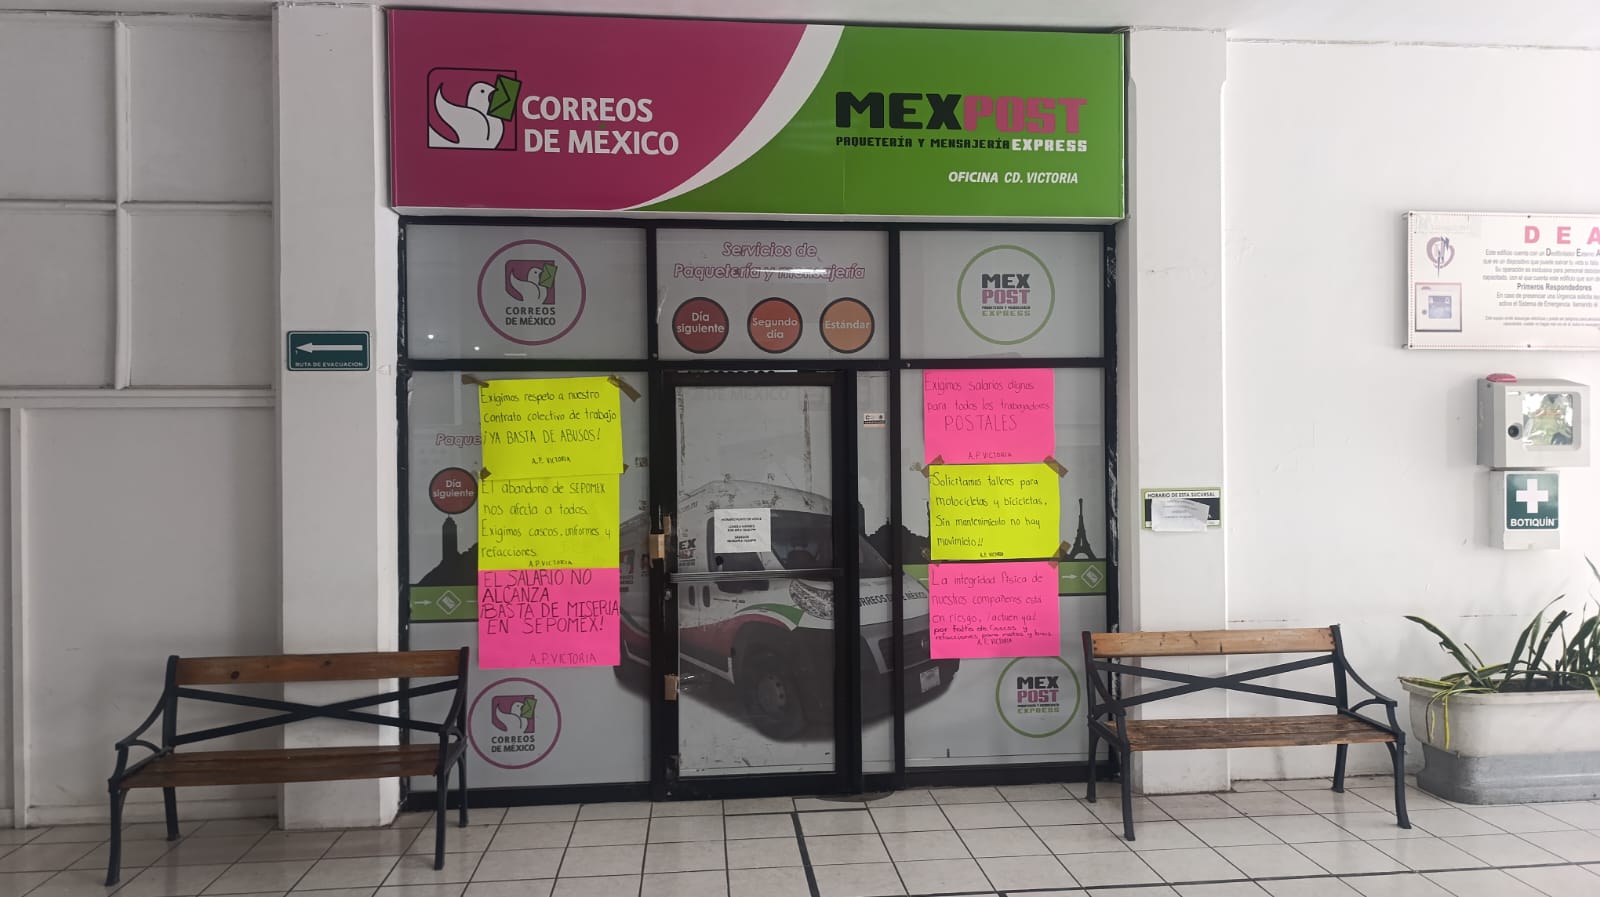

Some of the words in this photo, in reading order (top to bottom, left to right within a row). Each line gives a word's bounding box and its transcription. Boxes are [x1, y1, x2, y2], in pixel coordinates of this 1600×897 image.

[522, 95, 653, 123] CORREOS
[835, 91, 1088, 134] MEXPOST
[524, 128, 561, 153] DE
[568, 129, 679, 156] MEXICO
[918, 137, 925, 148] Y
[1012, 138, 1088, 152] EXPRESS
[948, 171, 999, 183] OFICINA
[1004, 172, 1023, 184] CD.
[1026, 172, 1078, 184] VICTORIA
[721, 241, 791, 258] Servicios
[795, 242, 818, 257] de
[673, 262, 761, 282] Paquetería
[763, 265, 775, 281] y
[777, 262, 866, 283] mensajería
[981, 273, 1030, 289] MEX
[1516, 282, 1544, 291] Primeros
[1546, 282, 1593, 293] Respondedores
[981, 289, 1030, 305] POST
[505, 306, 556, 316] CORREOS
[691, 311, 710, 322] Día
[505, 317, 517, 326] DE
[519, 315, 556, 326] MÉXICO
[752, 317, 798, 329] Segundo
[824, 318, 871, 330] Estándar
[676, 324, 725, 335] siguiente
[766, 330, 785, 340] día
[924, 372, 962, 396] Exigimos
[1007, 378, 1034, 394] dignos
[480, 387, 520, 406] Exigimos
[524, 391, 555, 405] respeto
[558, 392, 564, 401] a
[568, 390, 600, 400] nuestro
[927, 402, 947, 412] para
[955, 400, 978, 411] todos
[981, 397, 994, 411] los
[527, 410, 565, 422] colectivo
[569, 409, 580, 420] de
[585, 407, 617, 423] trabajo
[944, 413, 1018, 432] POSTALES
[435, 433, 480, 448] Paque
[506, 429, 537, 445] BASTA
[542, 429, 556, 444] DE
[560, 427, 601, 443] ABUSOS!
[546, 455, 571, 464] VICTORIA
[445, 479, 462, 488] Día
[481, 479, 494, 495] El
[501, 480, 549, 494] abandono
[552, 482, 564, 494] de
[569, 482, 606, 494] SEPOMEX
[930, 471, 982, 487] Solicitamos
[988, 475, 1014, 487] talleres
[1020, 479, 1039, 490] para
[432, 489, 475, 499] siguiente
[483, 504, 504, 516] nos
[509, 502, 538, 516] afecta
[544, 505, 553, 515] a
[993, 499, 1000, 509] y
[935, 514, 951, 528] Sin
[1010, 518, 1021, 526] no
[1025, 516, 1041, 530] hay
[1510, 515, 1555, 527] BOTIQUÍN
[481, 518, 522, 543] Exigimos
[604, 527, 611, 540] y
[481, 546, 537, 558] refacciones
[484, 571, 502, 587] EL
[506, 568, 565, 587] SALARIO
[570, 568, 593, 585] NO
[931, 568, 948, 586] La
[954, 572, 996, 589] integridad
[1031, 571, 1043, 583] de
[482, 586, 550, 604] ALCANZA
[932, 592, 968, 606] nuestros
[541, 601, 560, 618] DE
[567, 600, 620, 618] MISERIA
[487, 619, 510, 634] EN
[522, 616, 605, 634] SEPOMEX!
[934, 626, 948, 636] por
[976, 624, 988, 632] de
[1023, 624, 1028, 633] y
[551, 652, 597, 664] VICTORIA
[1016, 675, 1059, 690] MEX
[1016, 689, 1060, 704] POST
[491, 735, 536, 744] CORREOS
[491, 745, 502, 753] DE
[503, 742, 536, 752] MÉXICO
